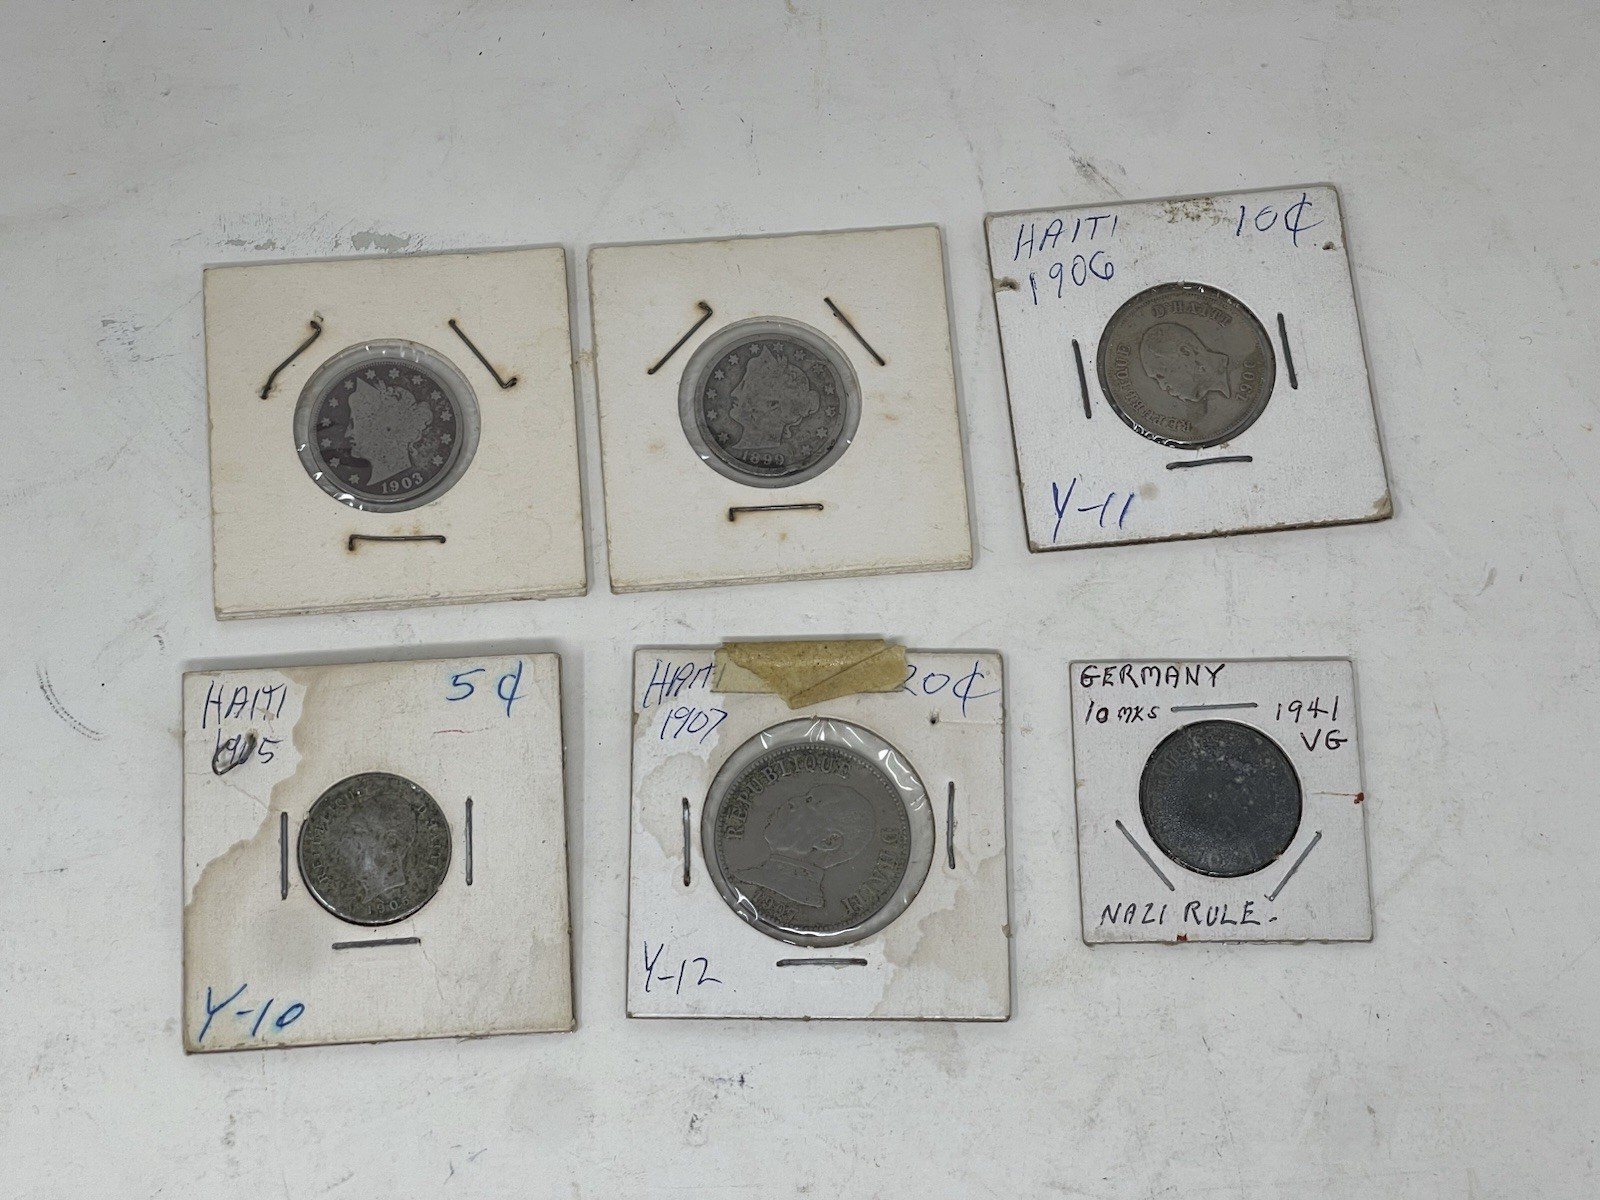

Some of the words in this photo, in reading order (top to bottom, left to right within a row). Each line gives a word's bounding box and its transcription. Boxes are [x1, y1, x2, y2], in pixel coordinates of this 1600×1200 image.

[1013, 214, 1118, 262] HAITI
[1235, 191, 1325, 248] 10¢
[1029, 250, 1115, 306] 1906
[381, 471, 424, 495] 1903
[1051, 477, 1135, 544] Y-11
[1079, 663, 1226, 689] GERMANY
[202, 679, 288, 730] HAITI
[660, 705, 729, 745] 1907
[1084, 699, 1110, 725] 10
[1275, 695, 1340, 724] 1941
[1300, 729, 1348, 752] VG
[1100, 902, 1168, 926] NAZI
[643, 940, 724, 996] Y-12
[198, 982, 306, 1043] Y-10
